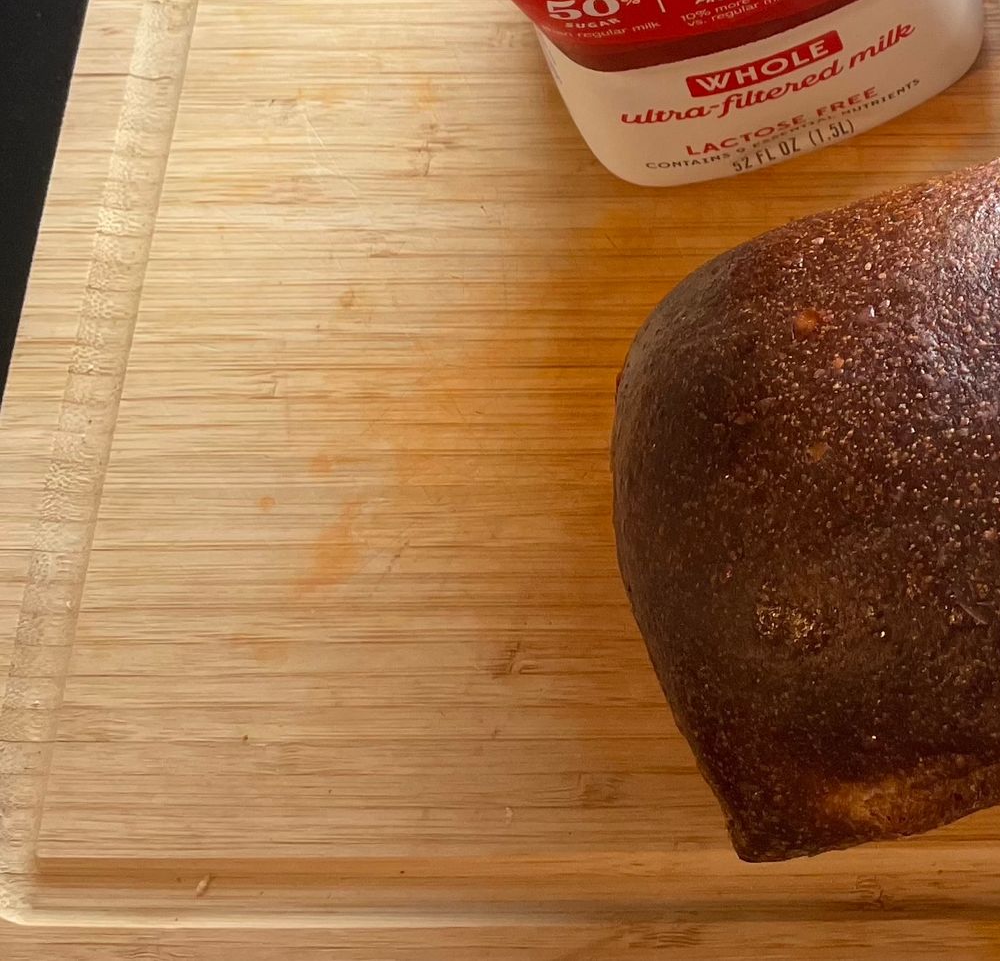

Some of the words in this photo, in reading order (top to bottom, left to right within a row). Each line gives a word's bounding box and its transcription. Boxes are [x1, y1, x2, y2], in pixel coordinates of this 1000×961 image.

[577, 26, 628, 39] regular
[632, 19, 662, 32] milk
[681, 8, 712, 22] 10%
[711, 1, 760, 22] regular
[621, 59, 844, 124] ultra-filtered
[849, 23, 916, 69] milk
[695, 39, 829, 93] WHOLE
[645, 151, 731, 170] CONTAINS
[841, 78, 921, 116] NUTRIENTS
[685, 114, 804, 156] LACTOSE
[815, 86, 878, 117] FREE
[731, 156, 753, 173] 52
[758, 149, 776, 166] FL
[781, 138, 802, 157] OZ
[808, 119, 856, 148] (1.5L)
